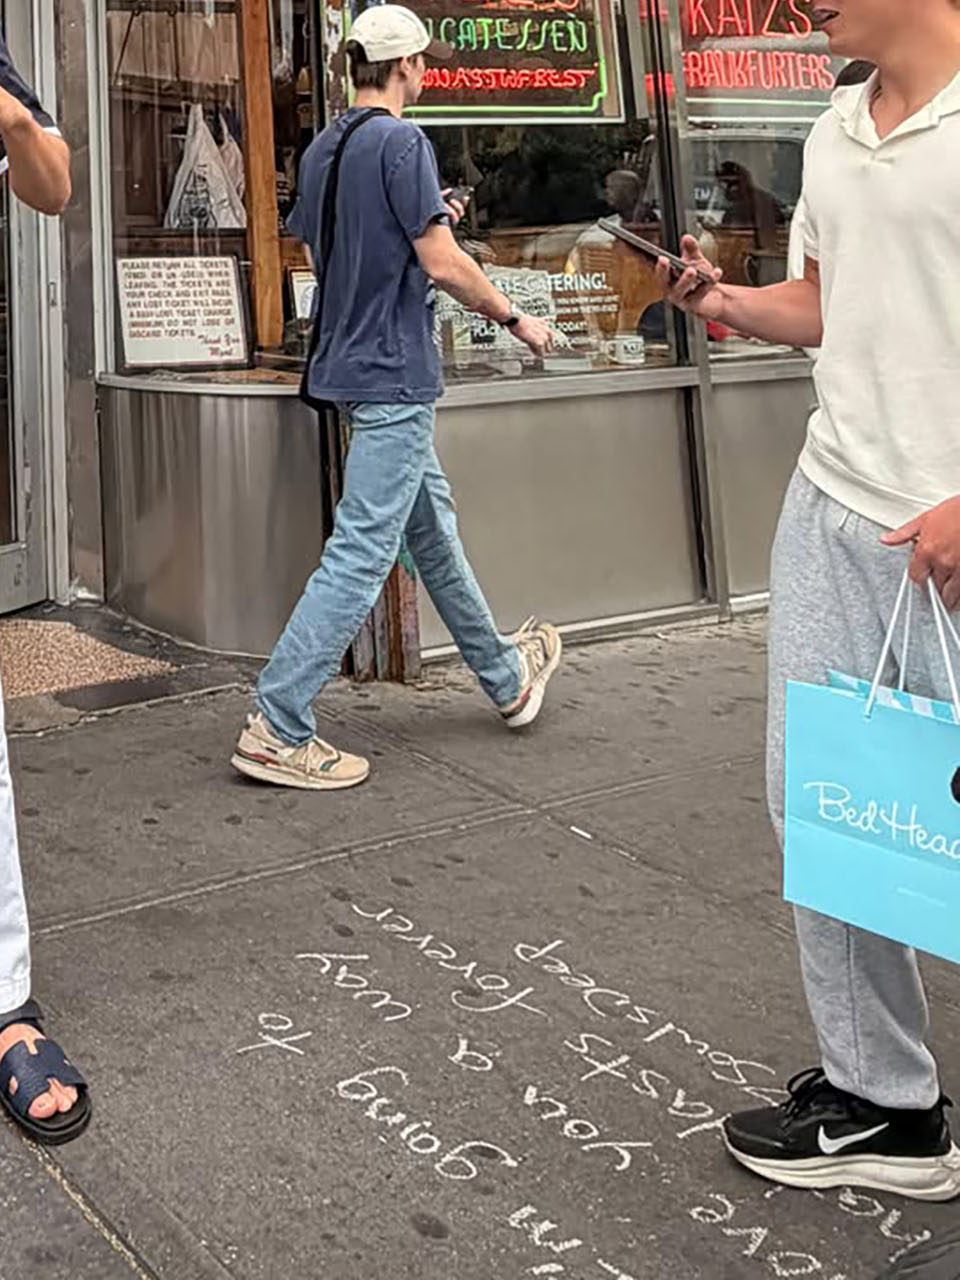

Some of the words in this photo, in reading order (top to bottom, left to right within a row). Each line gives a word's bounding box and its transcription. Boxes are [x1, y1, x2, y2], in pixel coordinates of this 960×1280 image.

[296, 952, 413, 1022] way
[351, 903, 547, 1017] forever
[238, 1011, 313, 1056] to
[449, 1034, 501, 1072] a
[336, 1064, 520, 1180] going
[524, 1085, 653, 1171] you
[563, 1031, 732, 1138] lasts
[688, 1192, 846, 1280] ove
